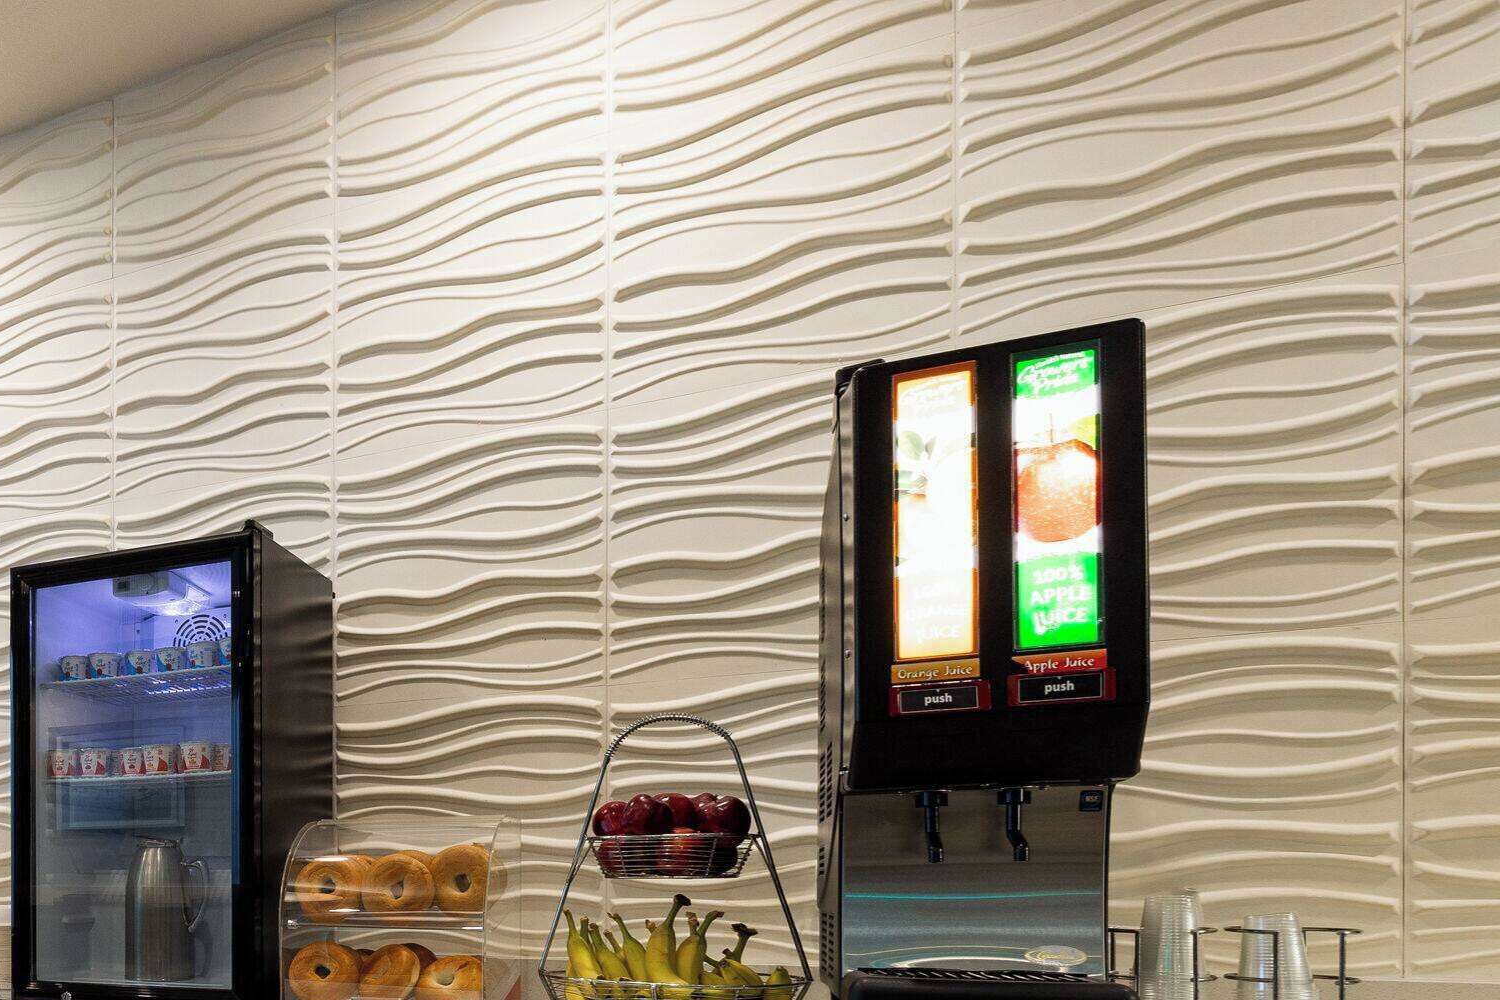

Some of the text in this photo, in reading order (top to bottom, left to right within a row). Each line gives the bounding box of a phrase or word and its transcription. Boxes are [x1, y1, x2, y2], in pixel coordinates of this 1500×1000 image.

[1030, 586, 1092, 607] APPLE
[1033, 607, 1090, 635] JUICE
[898, 665, 973, 680] Orange Juice
[1024, 657, 1095, 673] Apple Juice
[1044, 680, 1075, 695] push
[924, 692, 953, 706] push
